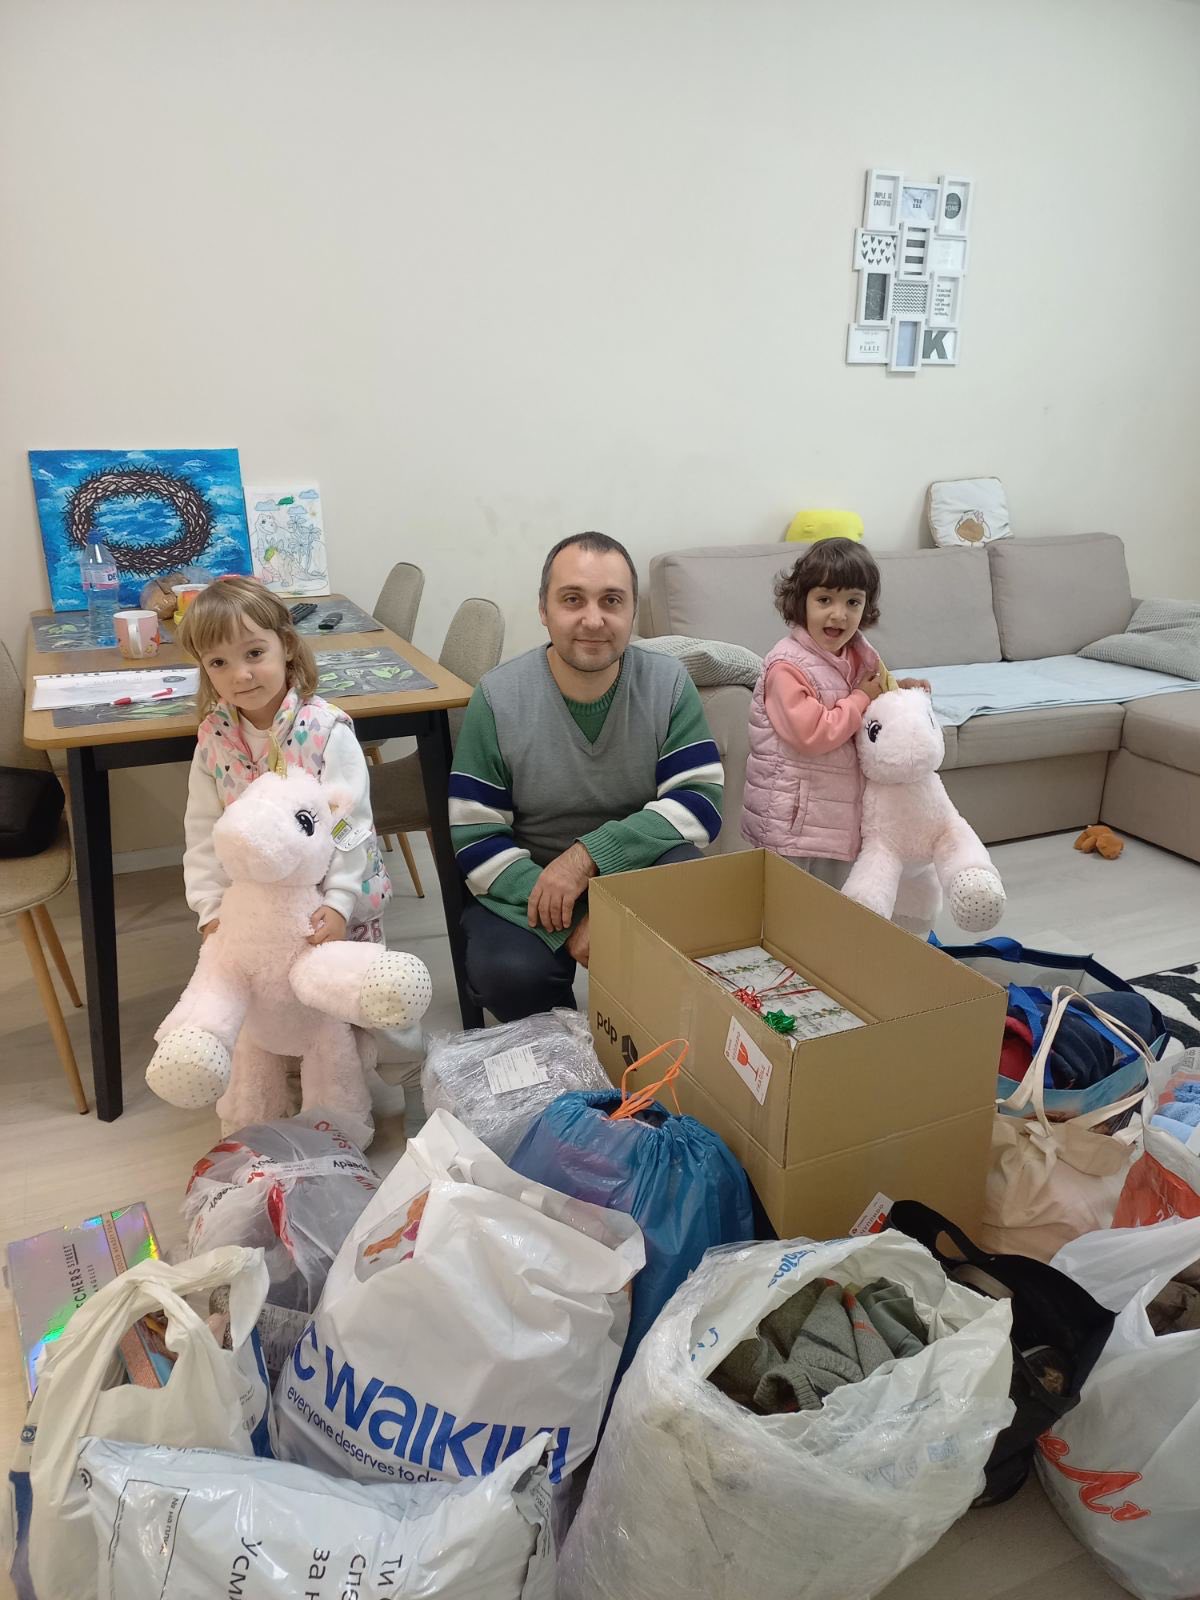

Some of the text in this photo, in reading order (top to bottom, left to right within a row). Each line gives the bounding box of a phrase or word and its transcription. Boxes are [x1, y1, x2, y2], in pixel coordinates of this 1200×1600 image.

[922, 330, 948, 359] K
[63, 1244, 87, 1308] ECHERS STREET
[287, 1385, 334, 1439] everyone
[335, 1430, 395, 1475] deserves
[398, 1465, 415, 1482] to
[308, 1547, 331, 1580] за
[377, 1554, 404, 1587] Ти
